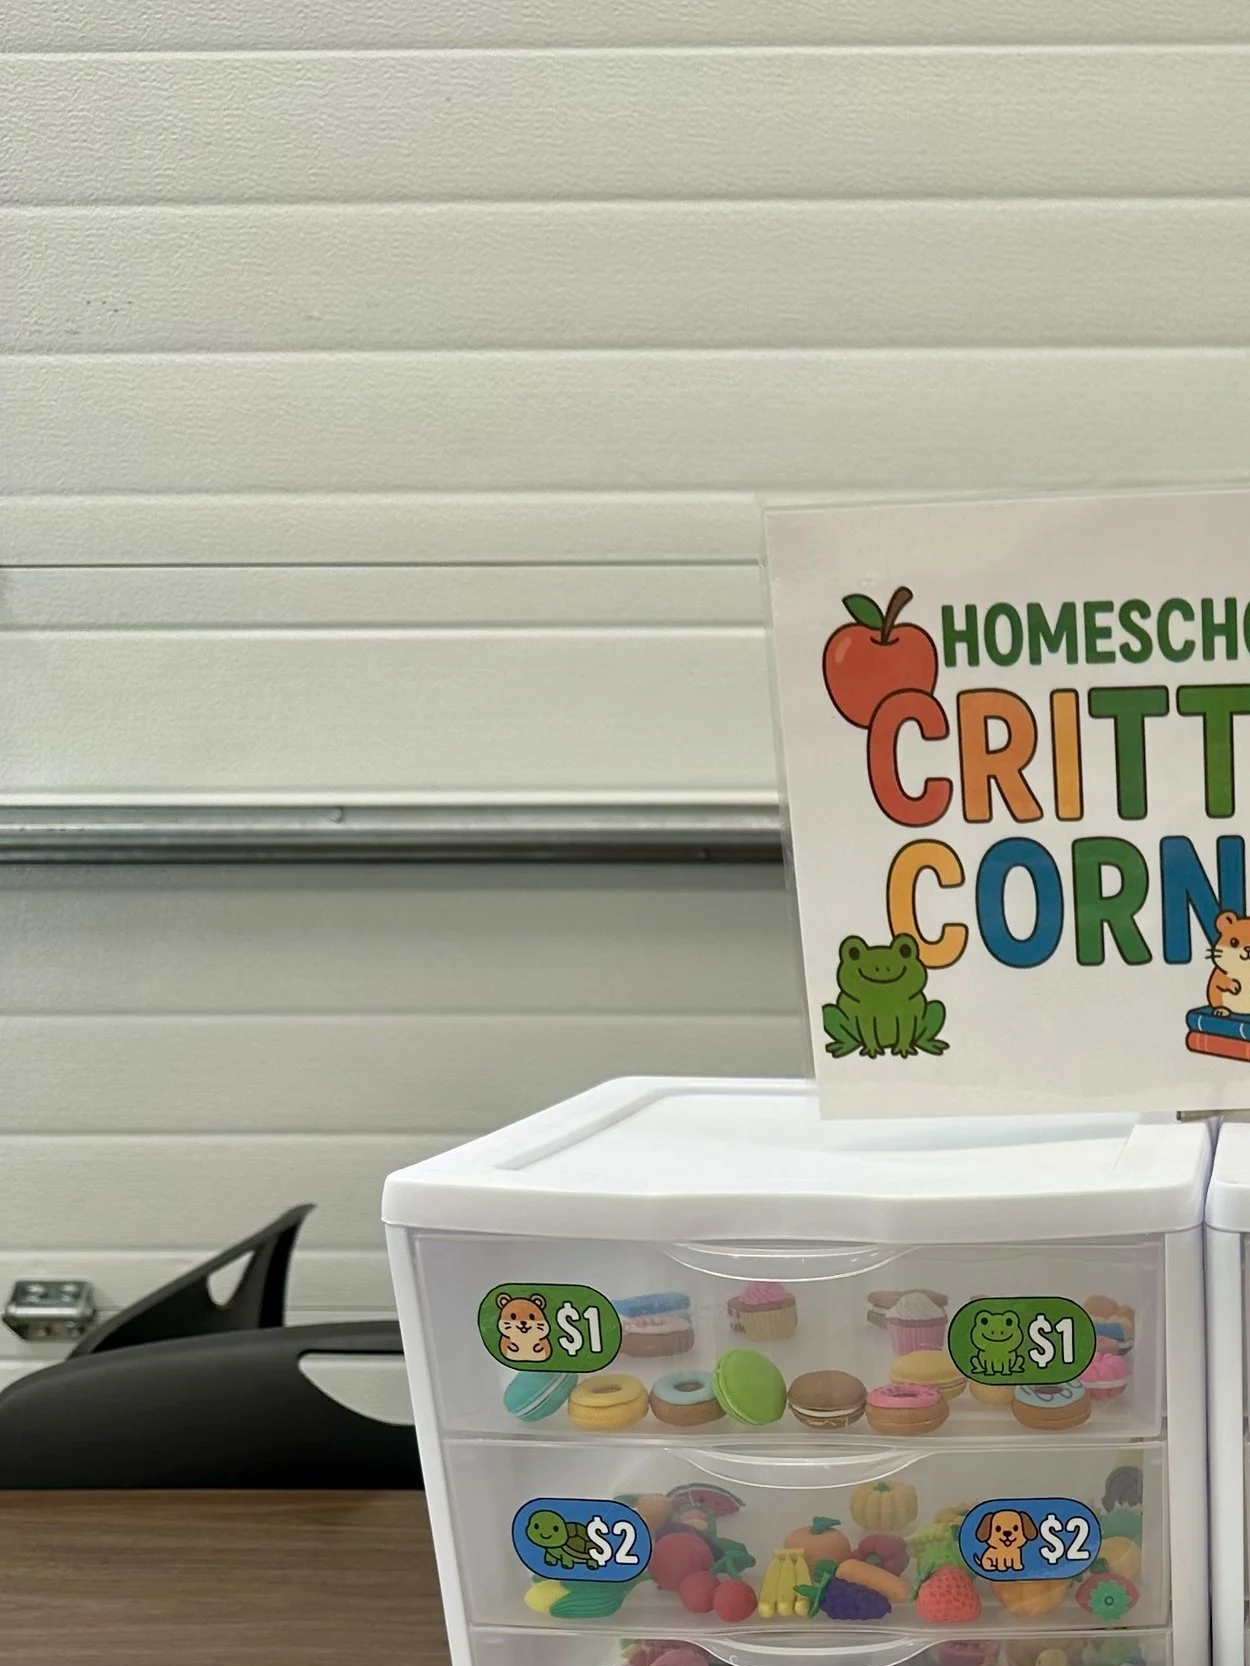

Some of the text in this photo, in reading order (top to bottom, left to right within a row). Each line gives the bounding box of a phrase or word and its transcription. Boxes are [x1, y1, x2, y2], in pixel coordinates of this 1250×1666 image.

[556, 1302, 603, 1357] $1
[1029, 1312, 1075, 1368] $1
[588, 1514, 639, 1567] $2
[1040, 1514, 1091, 1562] $2
